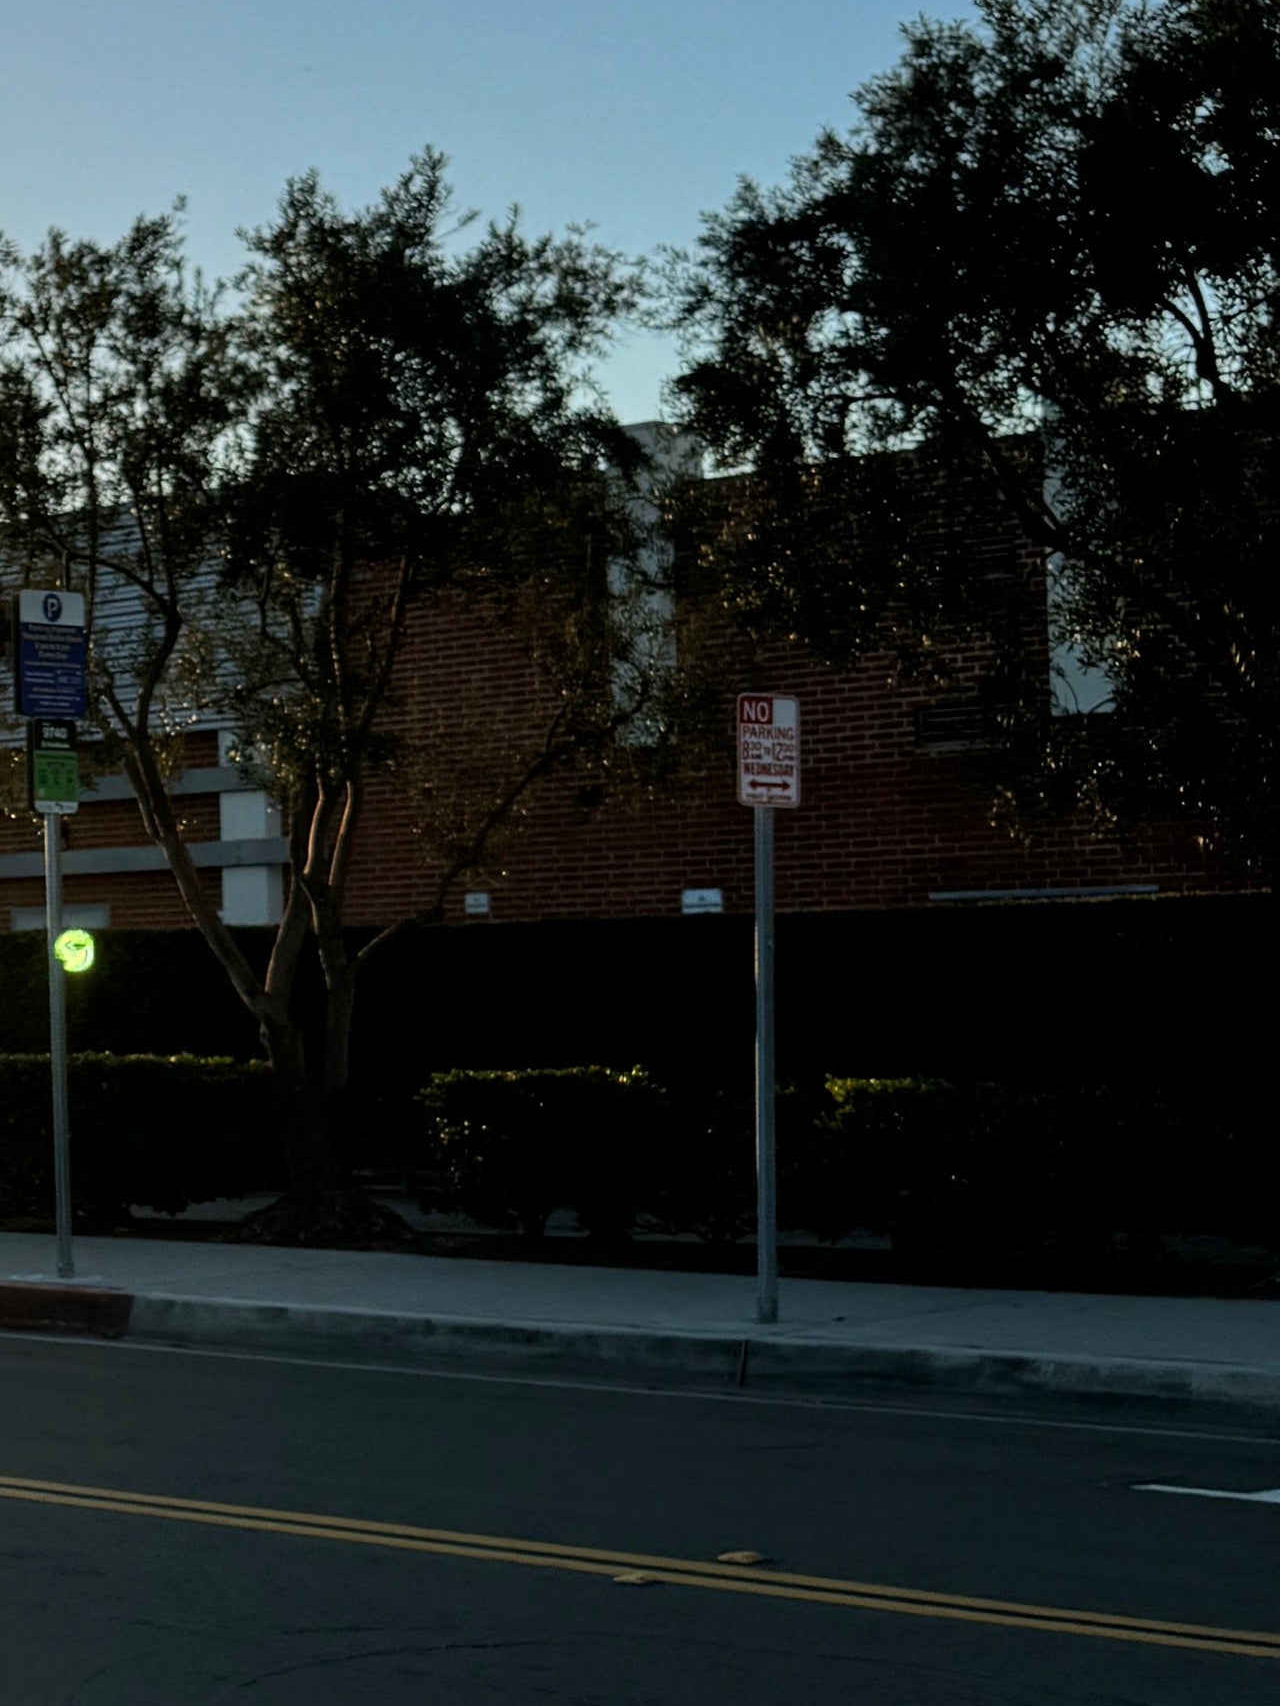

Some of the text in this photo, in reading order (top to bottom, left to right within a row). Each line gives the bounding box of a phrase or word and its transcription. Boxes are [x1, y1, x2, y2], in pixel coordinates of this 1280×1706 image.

[47, 598, 58, 618] P
[743, 700, 769, 723] NO
[742, 725, 795, 741] PARKING
[743, 762, 794, 777] WEDNESDAY
